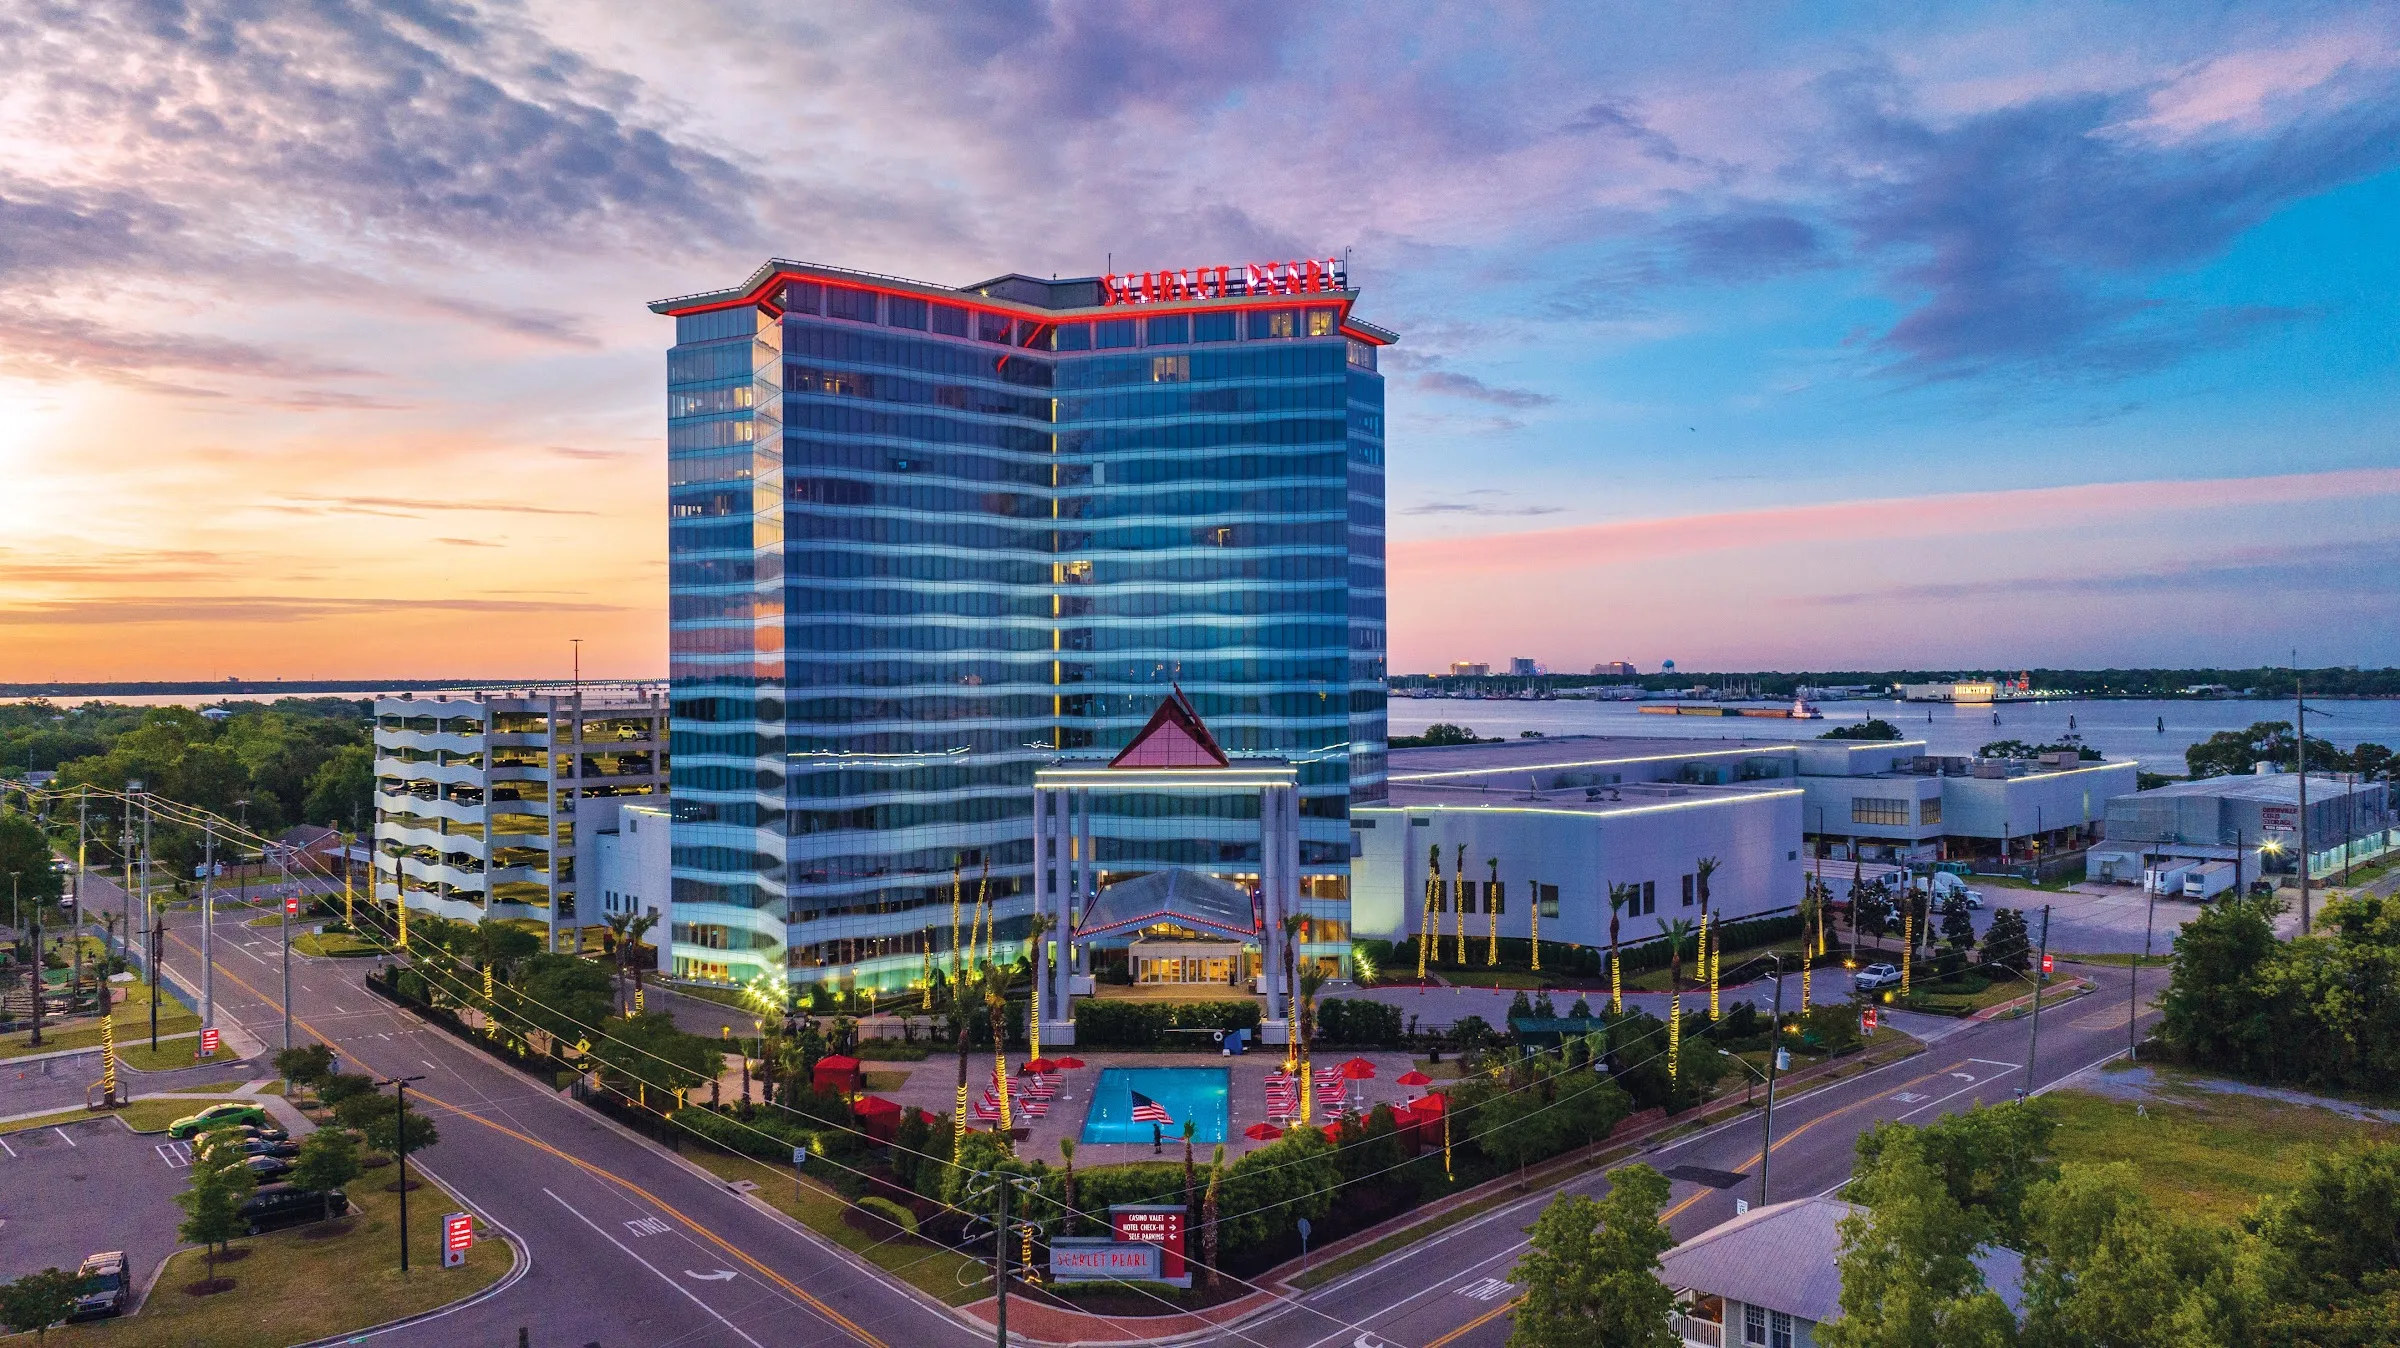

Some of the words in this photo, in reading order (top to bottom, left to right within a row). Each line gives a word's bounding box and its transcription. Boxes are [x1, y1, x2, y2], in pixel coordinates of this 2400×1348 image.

[1103, 265, 1229, 307] SCARLET
[1247, 257, 1341, 296] PEARL
[622, 1216, 671, 1238] ONLY
[1128, 1214, 1147, 1222] CASINO
[1149, 1214, 1164, 1222] VALET
[1057, 1252, 1106, 1267] SCARLET
[1111, 1253, 1148, 1267] PEARL
[1452, 1276, 1516, 1301] ONLY
